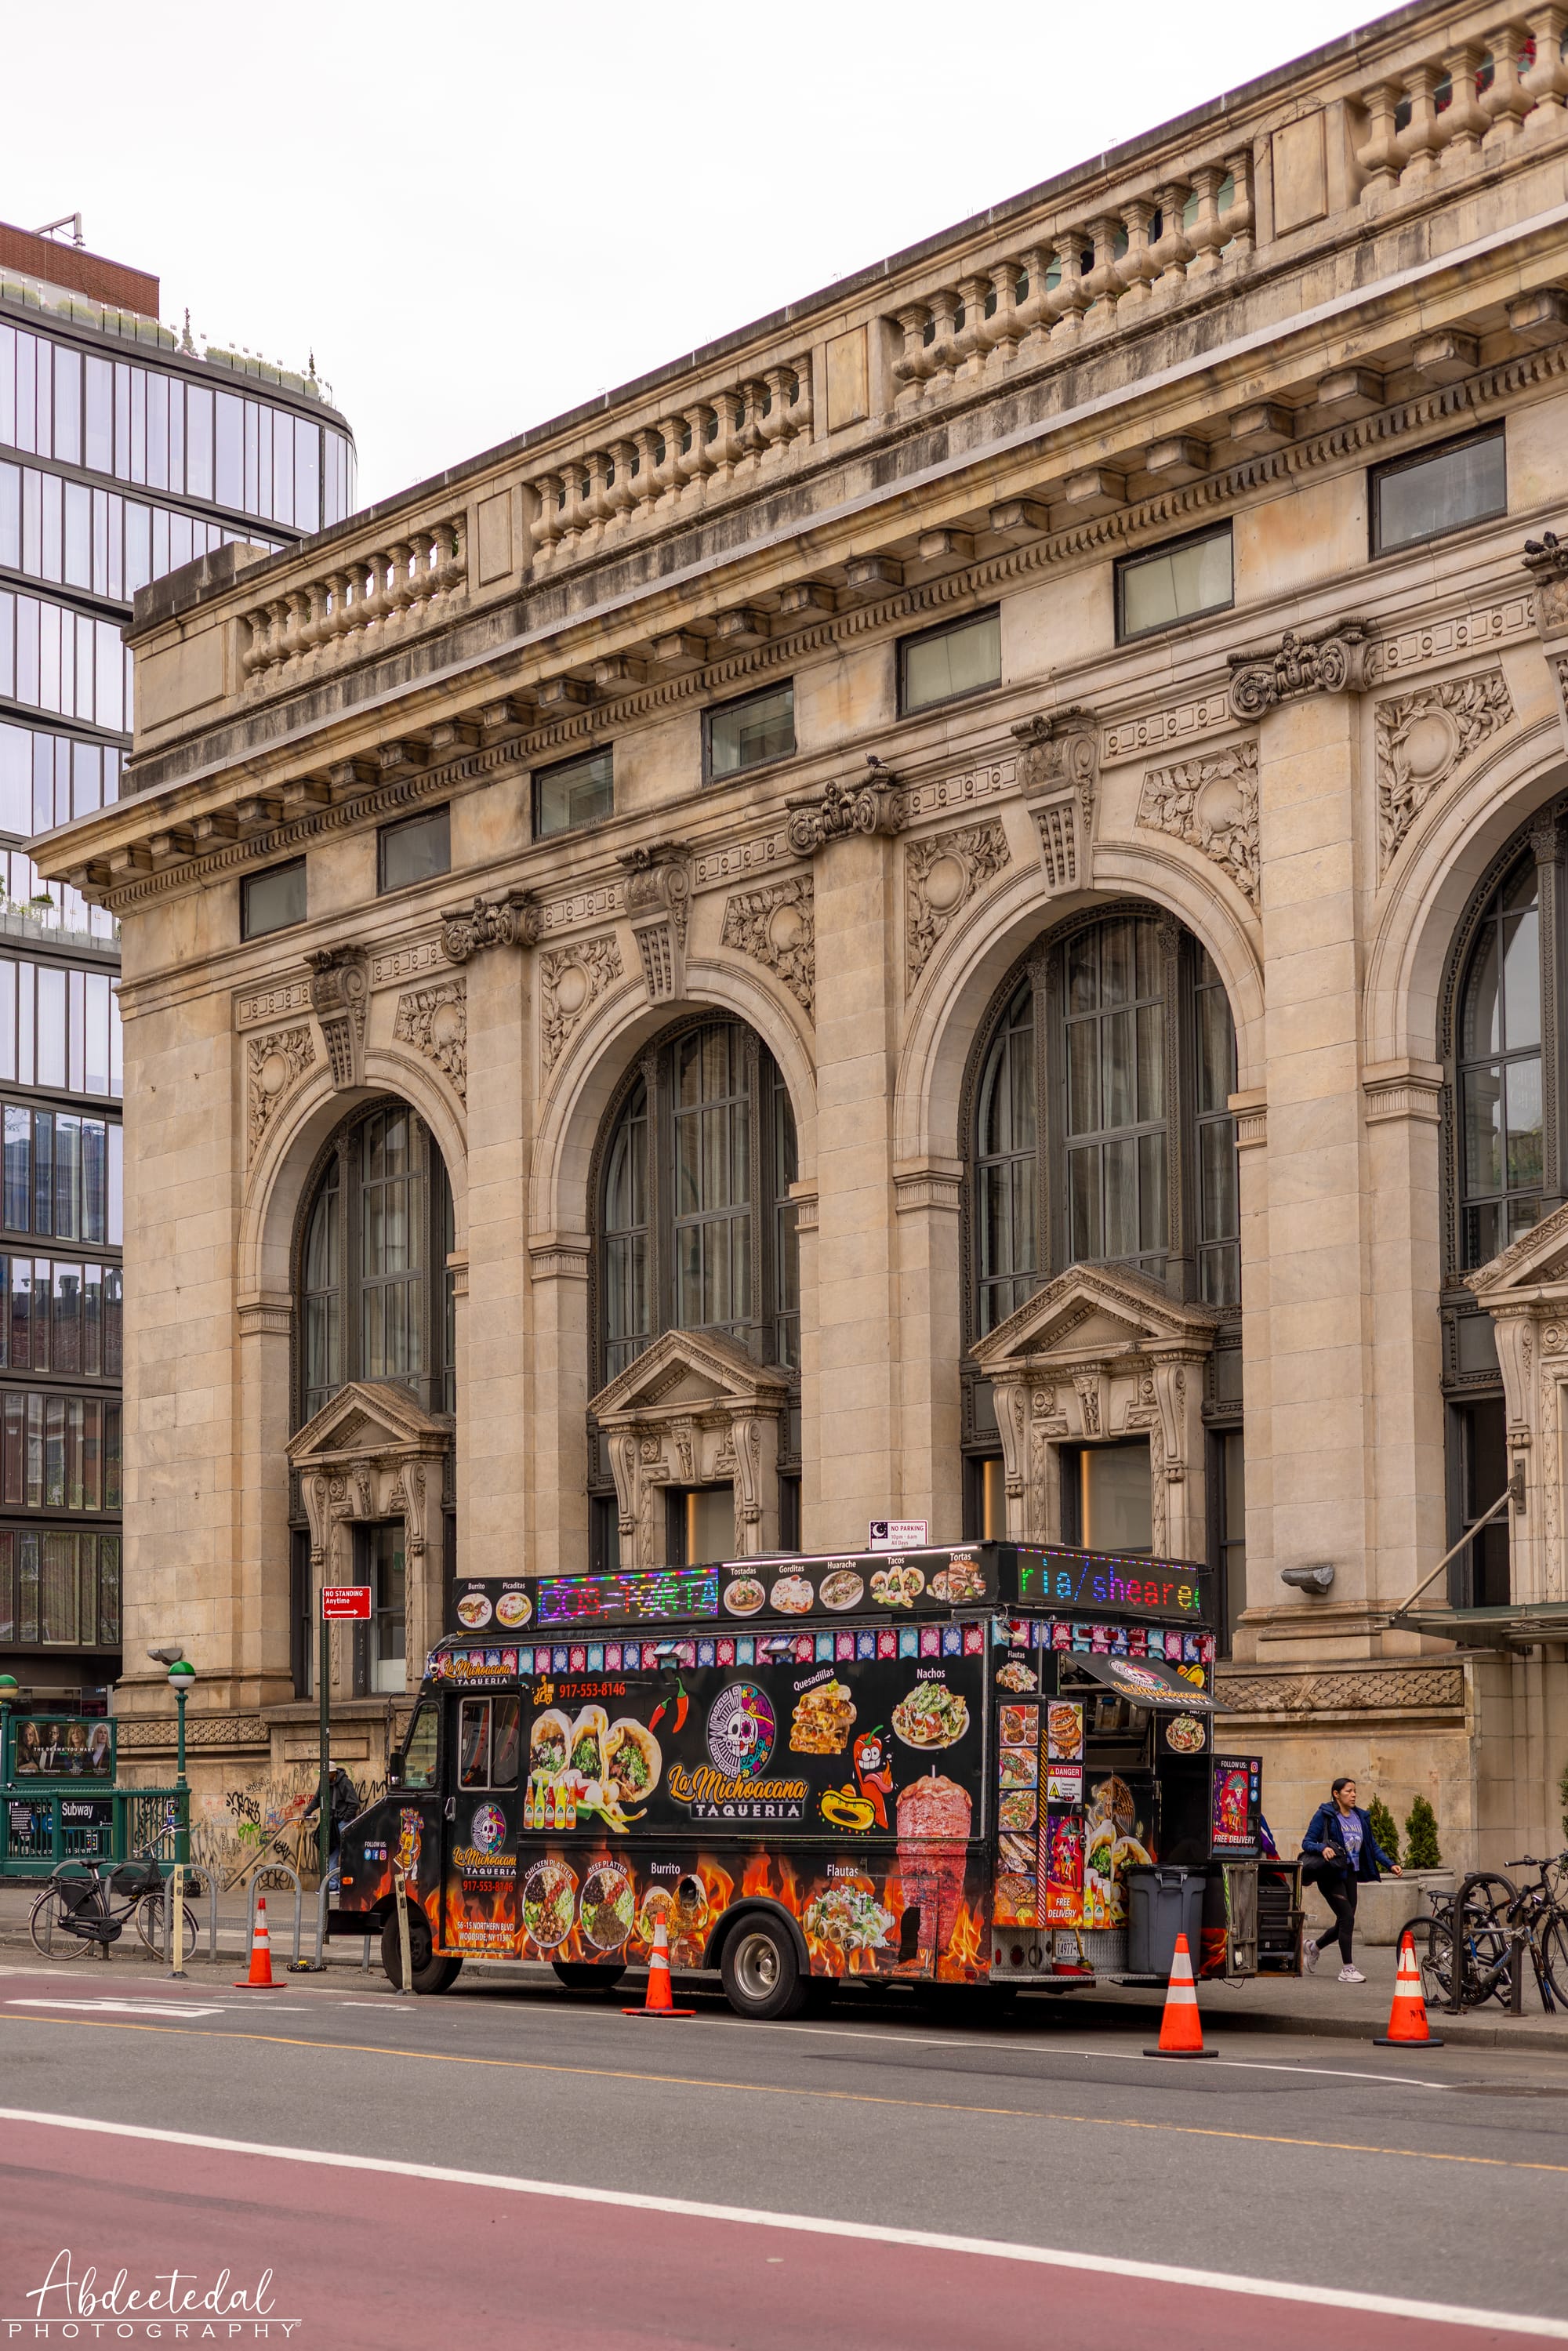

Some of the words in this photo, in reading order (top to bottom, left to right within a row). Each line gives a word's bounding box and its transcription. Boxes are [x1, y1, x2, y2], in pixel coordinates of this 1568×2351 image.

[887, 1556, 905, 1565] Tacos
[949, 1553, 971, 1562] Tortas
[827, 1561, 857, 1569] Huarache
[503, 1581, 525, 1590] Picaditas
[1007, 1650, 1025, 1659] Flautas
[444, 1659, 456, 1679] La
[456, 1658, 511, 1679] Michoacana
[916, 1668, 946, 1679] Nachos
[793, 1667, 835, 1692] Quesadillas
[559, 1682, 626, 1698] 917-553-8146
[1055, 1768, 1080, 1776] DANGER
[668, 1764, 695, 1802] La
[691, 1765, 809, 1804] Michoacana
[61, 1802, 93, 1819] Subway
[695, 1805, 800, 1817] TAQUERIA
[1214, 1834, 1228, 1843] FREE
[1229, 1835, 1256, 1845] DELIVERY
[452, 1846, 466, 1867] La
[465, 1848, 517, 1868] Michoacan
[466, 1867, 517, 1876] TAQUERIA
[525, 1859, 549, 1880] CHICKEN
[550, 1859, 573, 1881] PLATTER
[588, 1862, 602, 1874] BEEF
[602, 1860, 627, 1876] PLATTER
[651, 1863, 681, 1874] Burrito
[827, 1864, 858, 1877] Flautas
[463, 1880, 514, 1892] 917-553-8146
[1056, 1897, 1071, 1907] FREE
[1047, 1909, 1076, 1918] DELIVERY
[473, 1921, 500, 1930] NORTHERN
[459, 1932, 488, 1943] WOODSIDE,
